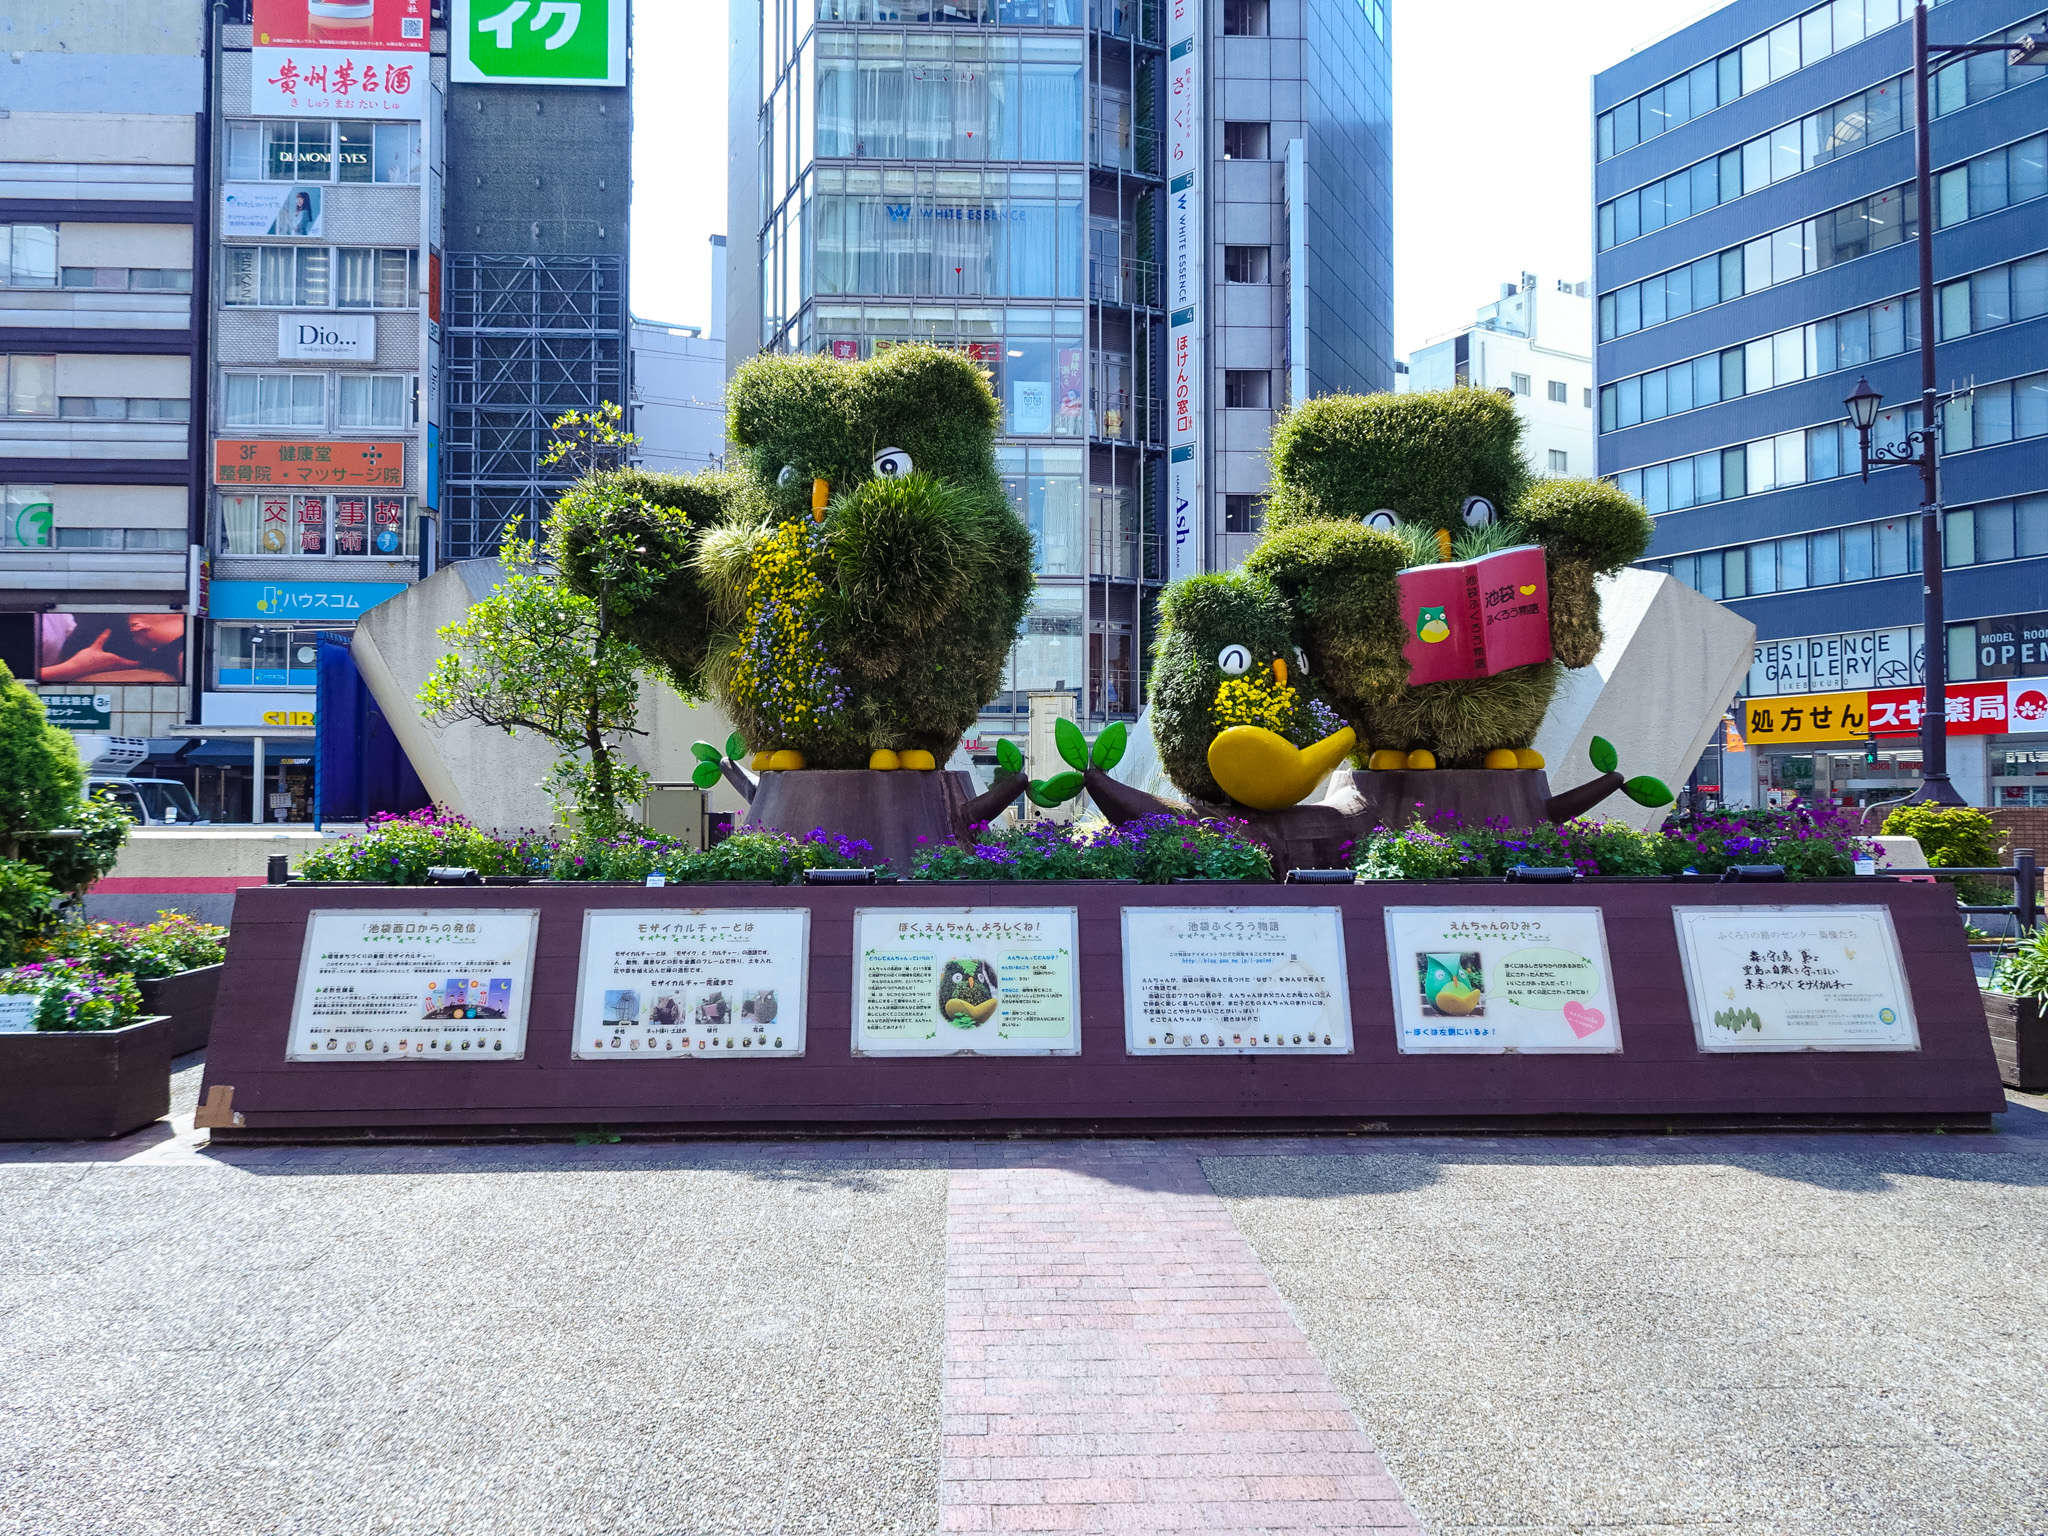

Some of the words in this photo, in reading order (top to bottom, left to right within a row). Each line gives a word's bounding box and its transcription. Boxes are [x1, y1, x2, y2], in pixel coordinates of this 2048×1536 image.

[478, 1, 581, 50] イク
[1185, 39, 1193, 53] 6
[268, 58, 413, 95] 貴州茅台酒
[290, 98, 299, 107] き
[307, 98, 330, 108] しゅう
[335, 99, 354, 109] まお
[358, 100, 379, 109] たい
[383, 100, 400, 109] しゅ
[1172, 77, 1184, 161] さくら
[1185, 175, 1193, 188] 5
[920, 208, 963, 219] WHITE
[1178, 213, 1187, 251] WHITE
[241, 252, 252, 298] RINKAN
[1178, 253, 1187, 303] ESSENCE
[1186, 309, 1194, 321] 4
[298, 325, 357, 345] Dio...
[1176, 335, 1189, 431] ほけんの窓口
[240, 445, 258, 460] 3F
[279, 446, 332, 462] 健康堂
[1187, 447, 1194, 459] 3
[264, 500, 400, 525] 交通事故
[1176, 497, 1190, 546] Ash
[301, 531, 362, 551] 施術
[283, 593, 360, 608] ハウスコム
[1485, 584, 1515, 609] 池袋
[1981, 632, 2015, 644] MODEL
[2024, 629, 2048, 640] ROO
[1755, 635, 1890, 663] RESIDENCE
[1766, 656, 1872, 681] GALLERY
[1784, 678, 1849, 691] IKEBUKURO
[1751, 704, 1863, 734] 処方せん
[638, 923, 754, 933] モザイカルチャーとは
[1188, 921, 1280, 931] 池袋ふくろう物語
[1450, 921, 1541, 931] えんちゃんのひみつ
